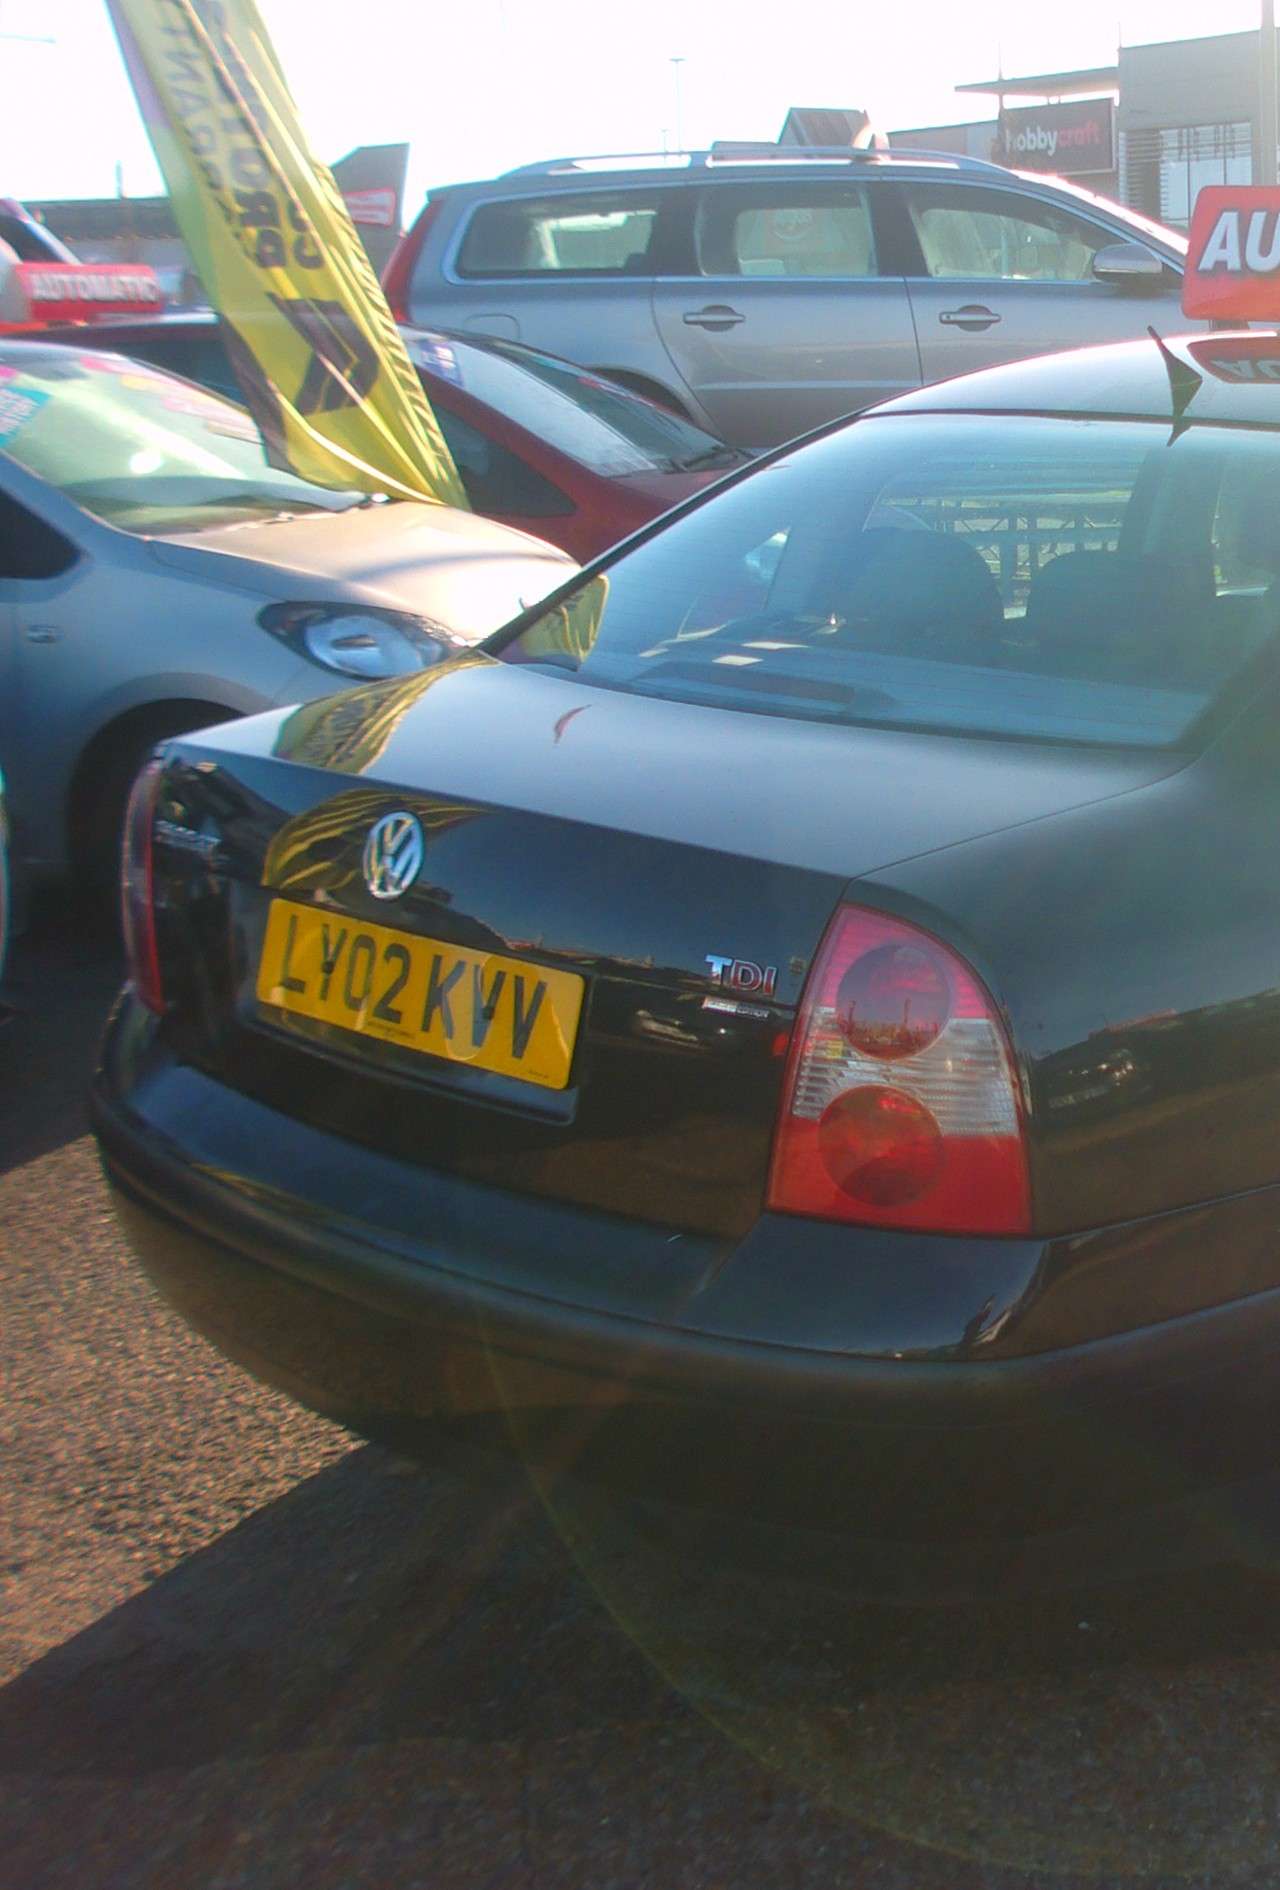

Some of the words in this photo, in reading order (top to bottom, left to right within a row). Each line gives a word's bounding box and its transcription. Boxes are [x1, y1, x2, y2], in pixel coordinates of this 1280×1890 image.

[30, 272, 159, 304] AUTOMATIC
[282, 914, 411, 1024] LY02
[705, 954, 777, 995] TDI
[421, 954, 547, 1059] KVV
